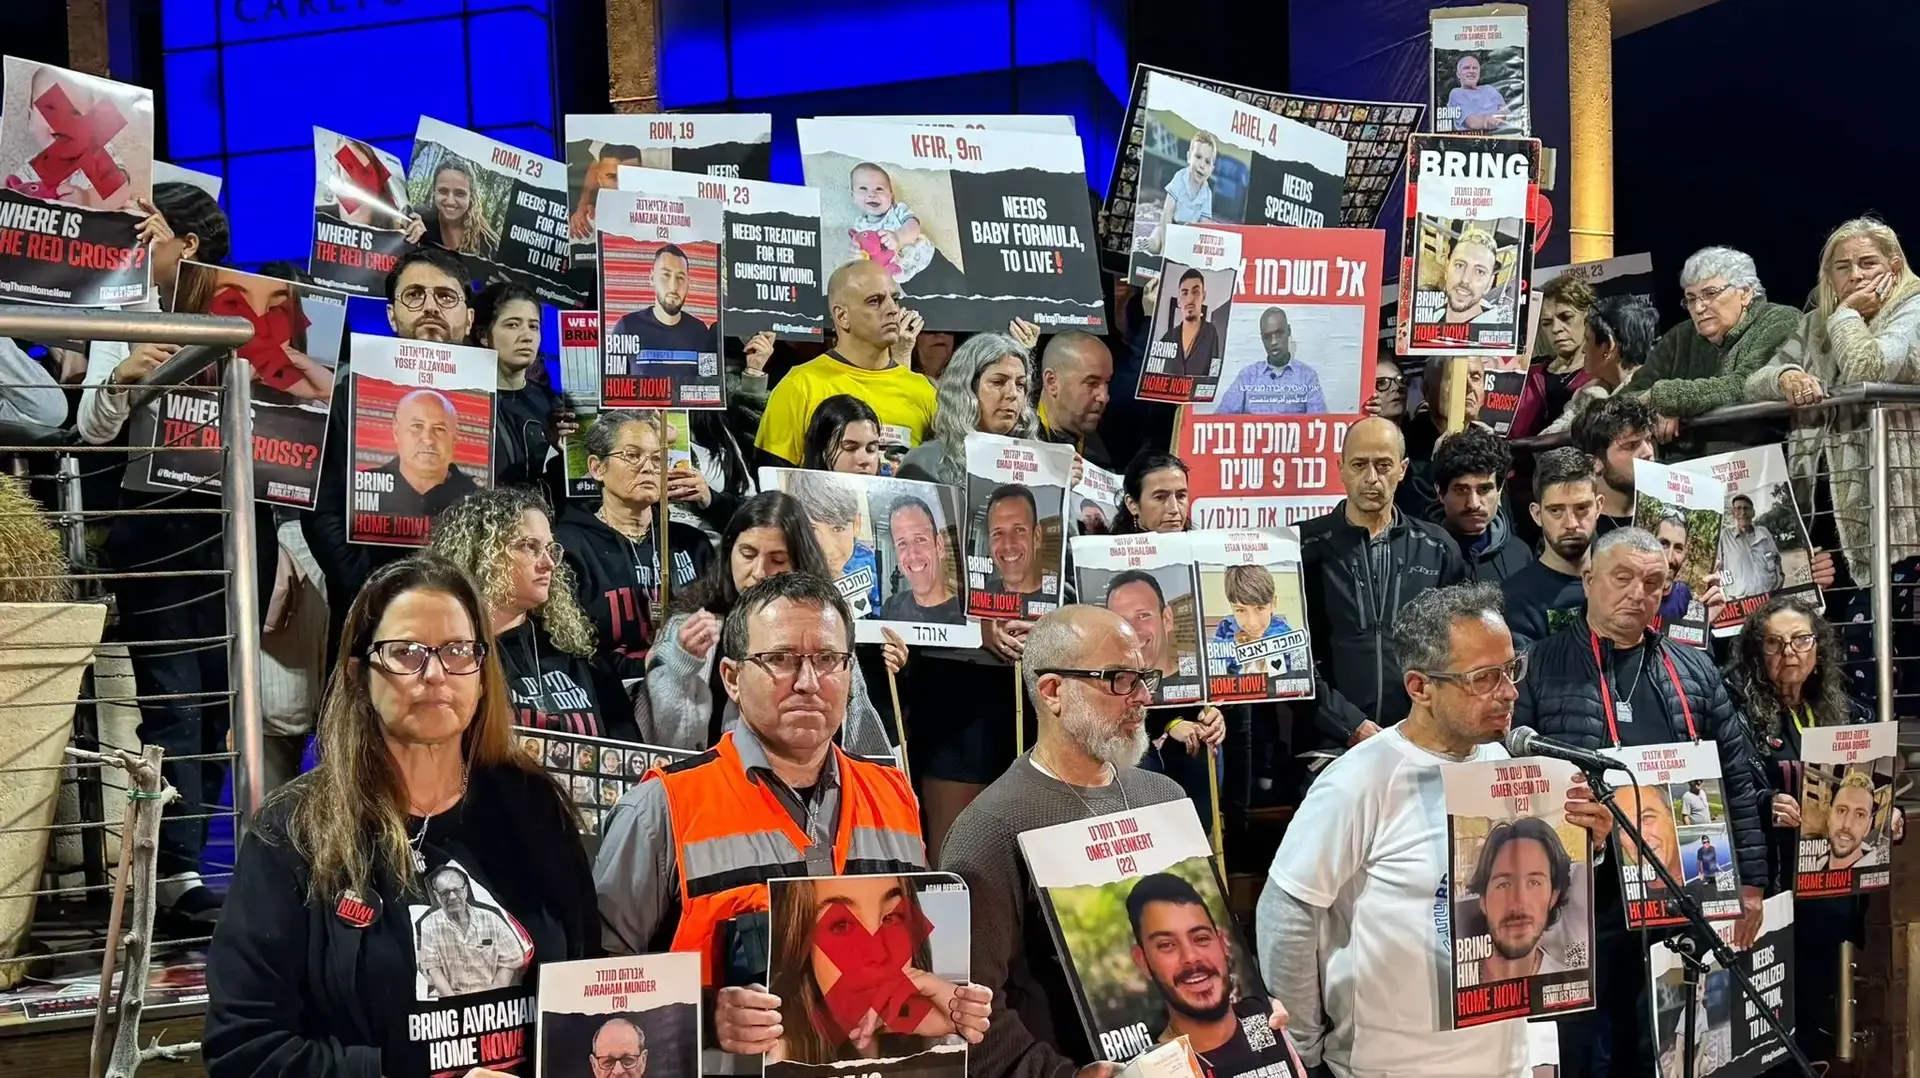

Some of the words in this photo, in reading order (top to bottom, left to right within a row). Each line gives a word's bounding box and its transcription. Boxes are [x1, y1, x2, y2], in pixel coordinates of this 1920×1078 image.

[1437, 107, 1461, 120] BRING
[649, 121, 676, 143] RON,
[679, 121, 695, 140] 19
[1230, 109, 1265, 147] ARIEL,
[1267, 123, 1279, 147] 4
[1436, 119, 1453, 132] HIM
[911, 133, 954, 164] KFIR,
[955, 137, 984, 162] 9m
[491, 146, 523, 176] ROMI,
[525, 159, 544, 179] 23
[1420, 150, 1530, 179] BRING
[697, 181, 731, 206] ROMI,
[733, 186, 750, 205] 23
[1282, 173, 1314, 204] NEEDS
[516, 190, 548, 215] NEEDS
[1002, 195, 1048, 221] NEEDS
[1264, 195, 1325, 229] SPECIALIZED
[1450, 196, 1471, 207] ELKANA
[0, 200, 62, 236] WHERE
[62, 211, 84, 240] IS
[629, 212, 659, 225] HAMZAH
[659, 214, 692, 228] ALZAYADNI
[1465, 207, 1478, 218] (34)
[317, 221, 358, 250] WHERE
[360, 231, 374, 251] IS
[535, 215, 554, 236] FOR
[656, 226, 670, 239] (22)
[732, 222, 762, 242] NEEDS
[763, 225, 817, 248] TREATMENT
[510, 224, 554, 252] GUNSHOT
[971, 220, 1012, 246] BABY
[1012, 222, 1086, 253] FORMULA,
[26, 234, 65, 264] RED
[68, 241, 147, 271] CROSS?
[315, 241, 338, 264] THE
[339, 248, 363, 268] RED
[527, 248, 540, 266] TO
[756, 244, 775, 262] FOR
[776, 247, 795, 265] HER
[1000, 249, 1022, 273] TO
[1023, 250, 1065, 275] LIVE!
[734, 261, 778, 282] GUNSHOT
[779, 266, 817, 288] WOUND,
[1254, 258, 1328, 297] תשכחו
[1336, 255, 1368, 298] אל
[1590, 264, 1604, 277] 23
[756, 283, 769, 300] TO
[1416, 290, 1445, 307] BRING
[568, 317, 586, 328] WE
[1414, 306, 1434, 323] HIM
[1414, 324, 1441, 341] HOME
[1443, 324, 1471, 342] NOW!
[605, 334, 641, 355] BRING
[1151, 341, 1179, 359] BRING
[394, 357, 417, 370] YOSEF
[418, 361, 457, 375] ALZAYADNI
[605, 354, 628, 376] HIM
[1146, 356, 1166, 374] HIM
[418, 372, 434, 385] (53)
[605, 377, 637, 398] HOME
[639, 376, 673, 399] NOW!
[1143, 374, 1170, 393] HOME
[1485, 373, 1495, 391] IS
[1486, 392, 1519, 412] CROSS?
[162, 418, 195, 448] THE
[1191, 421, 1237, 456] בבית
[1241, 421, 1301, 456] מחכים
[1307, 417, 1328, 454] לי
[995, 459, 1012, 471] OHAD
[1012, 461, 1040, 474] YAHALOMI
[1012, 470, 1025, 483] (49)
[1219, 456, 1266, 492] שנים
[1272, 458, 1286, 490] 9
[1290, 456, 1328, 490] כבר
[354, 470, 395, 493] BRING
[354, 490, 380, 512] HIM
[354, 513, 391, 535] HOME
[393, 515, 431, 538] NOW!
[1256, 506, 1278, 529] את
[1110, 547, 1126, 557] OHAD
[1127, 545, 1157, 557] YAHALOMI
[1242, 552, 1254, 563] (12)
[968, 555, 994, 574] BRING
[838, 571, 872, 592] מחכה
[969, 572, 986, 590] HIM
[970, 590, 993, 610] HOME
[993, 591, 1021, 611] NOW!
[1718, 601, 1741, 621] OME
[912, 626, 949, 643] אוהד
[1273, 632, 1303, 652] מחכה
[1207, 641, 1236, 659] BRING
[1237, 640, 1269, 661] לאבא
[1208, 658, 1227, 676] HIM
[1209, 678, 1238, 695] HOME
[1238, 675, 1266, 693] NOW!
[1832, 740, 1852, 752] ELKANA
[1852, 739, 1871, 750] BOHBOT
[1846, 750, 1858, 762] (34)
[1494, 767, 1508, 781] טוב
[1508, 767, 1522, 780] שם
[1521, 764, 1542, 780] עומר
[1636, 761, 1660, 772] ITZHAK
[1659, 759, 1687, 770] ELGARAT
[1490, 783, 1513, 799] OMER
[1513, 780, 1533, 798] SHEM
[1533, 778, 1550, 795] TOV
[1514, 797, 1530, 813] (21)
[1115, 817, 1139, 836] עומר
[1085, 840, 1114, 862] OMER
[1112, 832, 1154, 856] WENKERT
[1798, 839, 1828, 857] BRING
[1116, 855, 1139, 876] (22)
[1622, 864, 1657, 883] BRNG
[1798, 855, 1817, 873] HIM
[1797, 872, 1825, 891] HOME
[1825, 869, 1852, 889] NOW!
[337, 898, 376, 923] NOW!
[1456, 933, 1493, 963] BRING
[1752, 944, 1775, 972] NEEDS
[618, 966, 645, 982] אברהם
[1457, 961, 1481, 988] HIM
[583, 980, 624, 998] AVRAHAM
[624, 979, 657, 995] MUNDER
[1457, 984, 1492, 1017] HOME
[1492, 977, 1530, 1010] NOW!
[611, 994, 629, 1010] (78)
[408, 1010, 459, 1043] BRING
[1749, 1019, 1760, 1041] TO
[429, 1036, 479, 1071] HOME
[480, 1027, 526, 1062] NOW!
[1099, 1021, 1153, 1062] BRING
